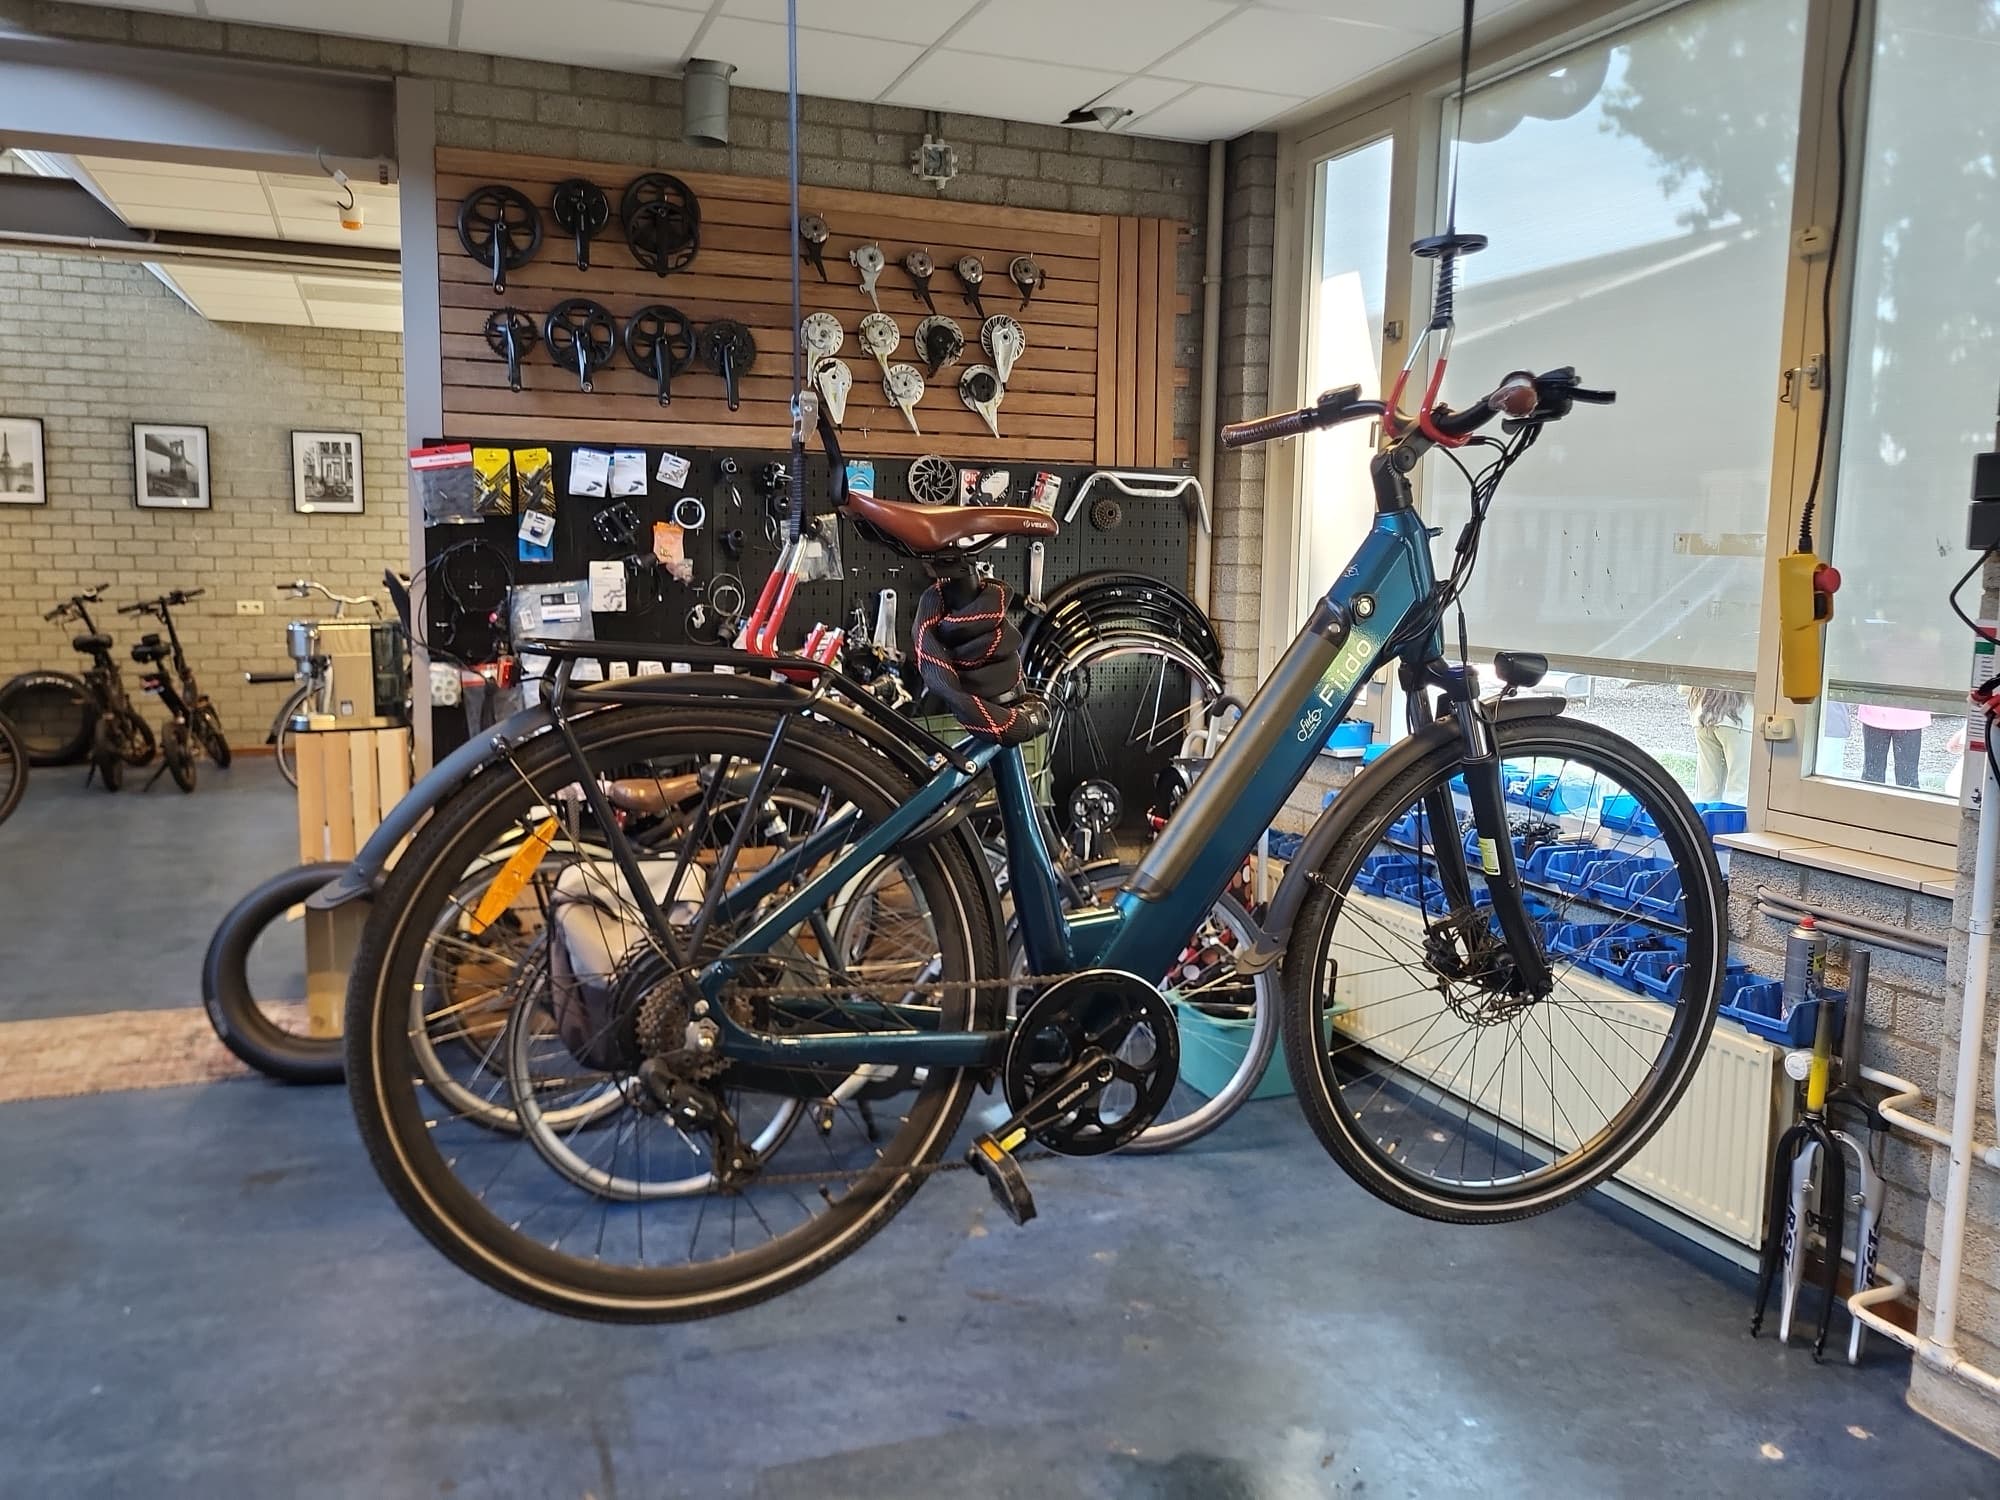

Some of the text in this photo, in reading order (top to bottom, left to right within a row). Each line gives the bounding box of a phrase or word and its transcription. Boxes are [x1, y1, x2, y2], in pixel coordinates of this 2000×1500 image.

[1319, 640, 1372, 708] Fiido
[1784, 1208, 1798, 1267] RST
[1866, 1228, 1879, 1287] RST
